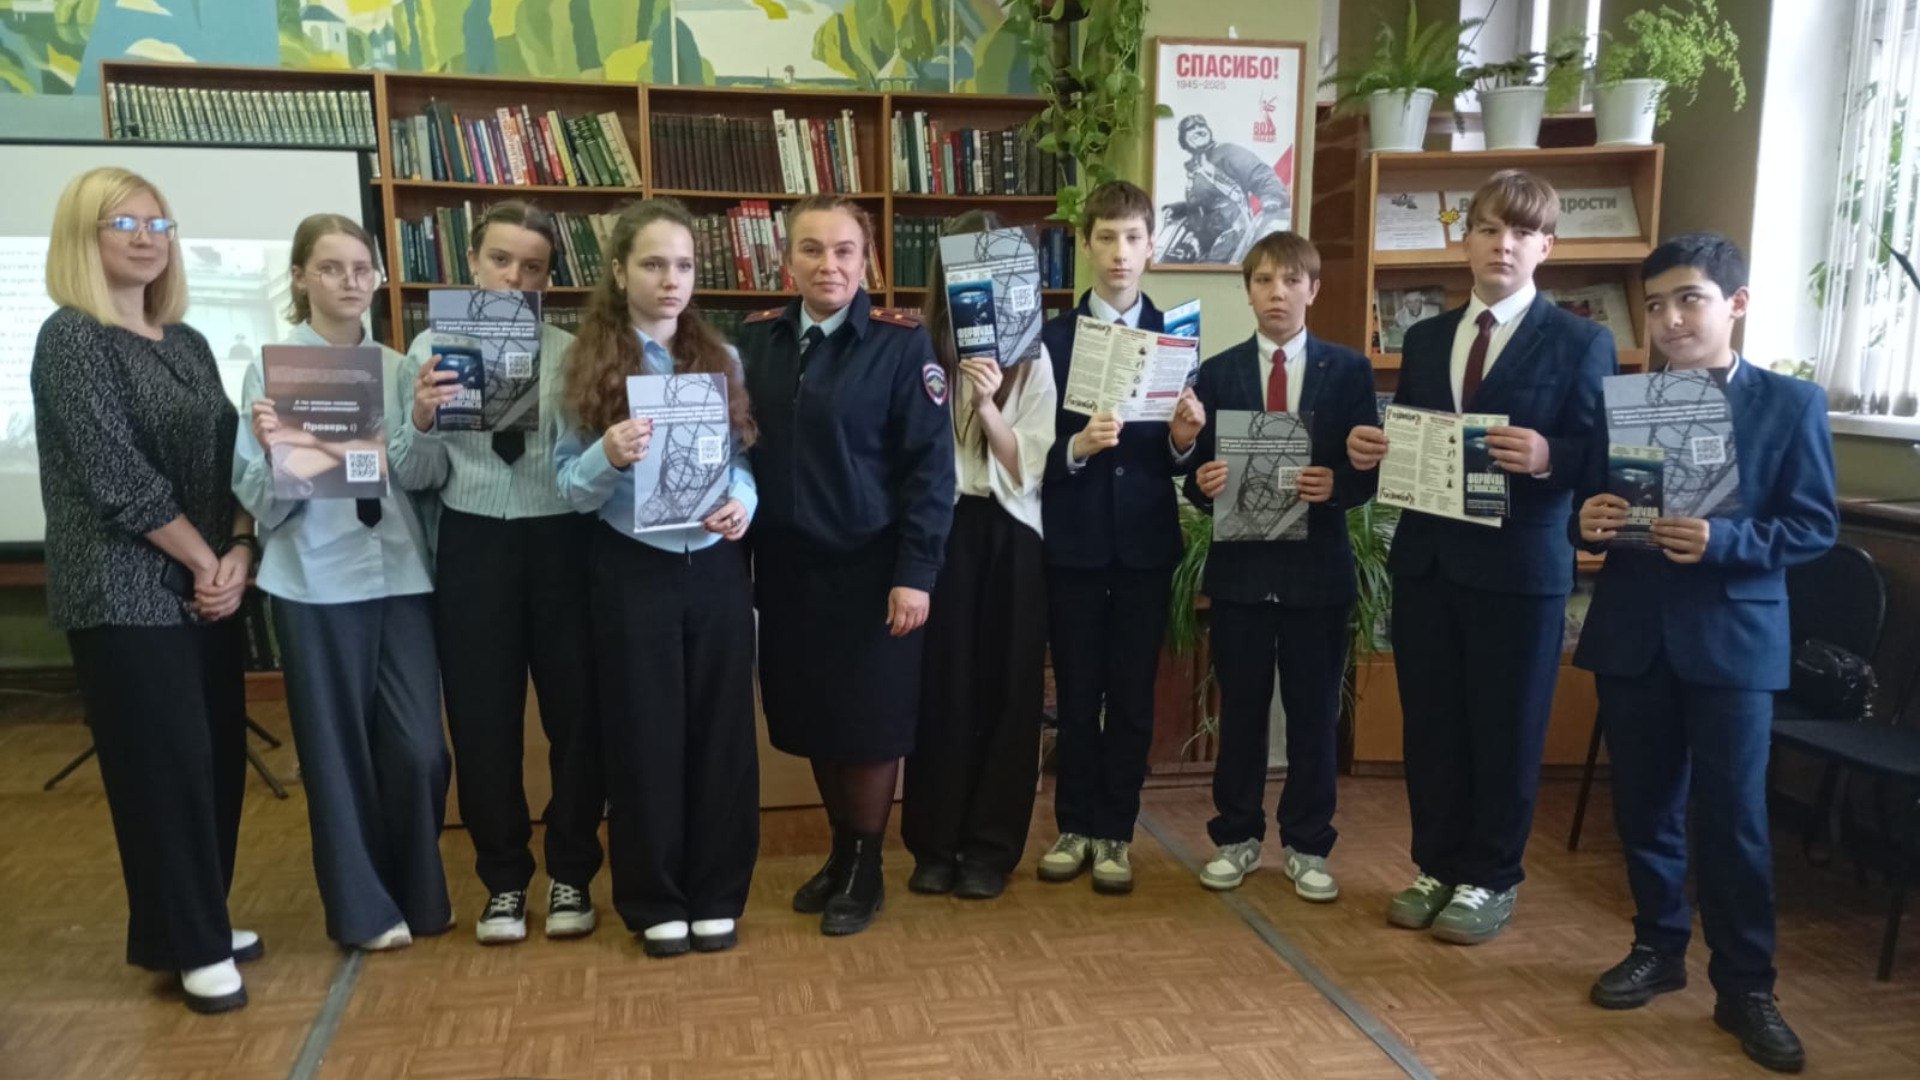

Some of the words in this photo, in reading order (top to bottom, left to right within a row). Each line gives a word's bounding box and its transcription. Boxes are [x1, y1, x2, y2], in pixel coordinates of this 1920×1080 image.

[1176, 53, 1279, 79] СПАСИБО!
[1558, 196, 1617, 213] дрости
[303, 422, 349, 433] Проверь
